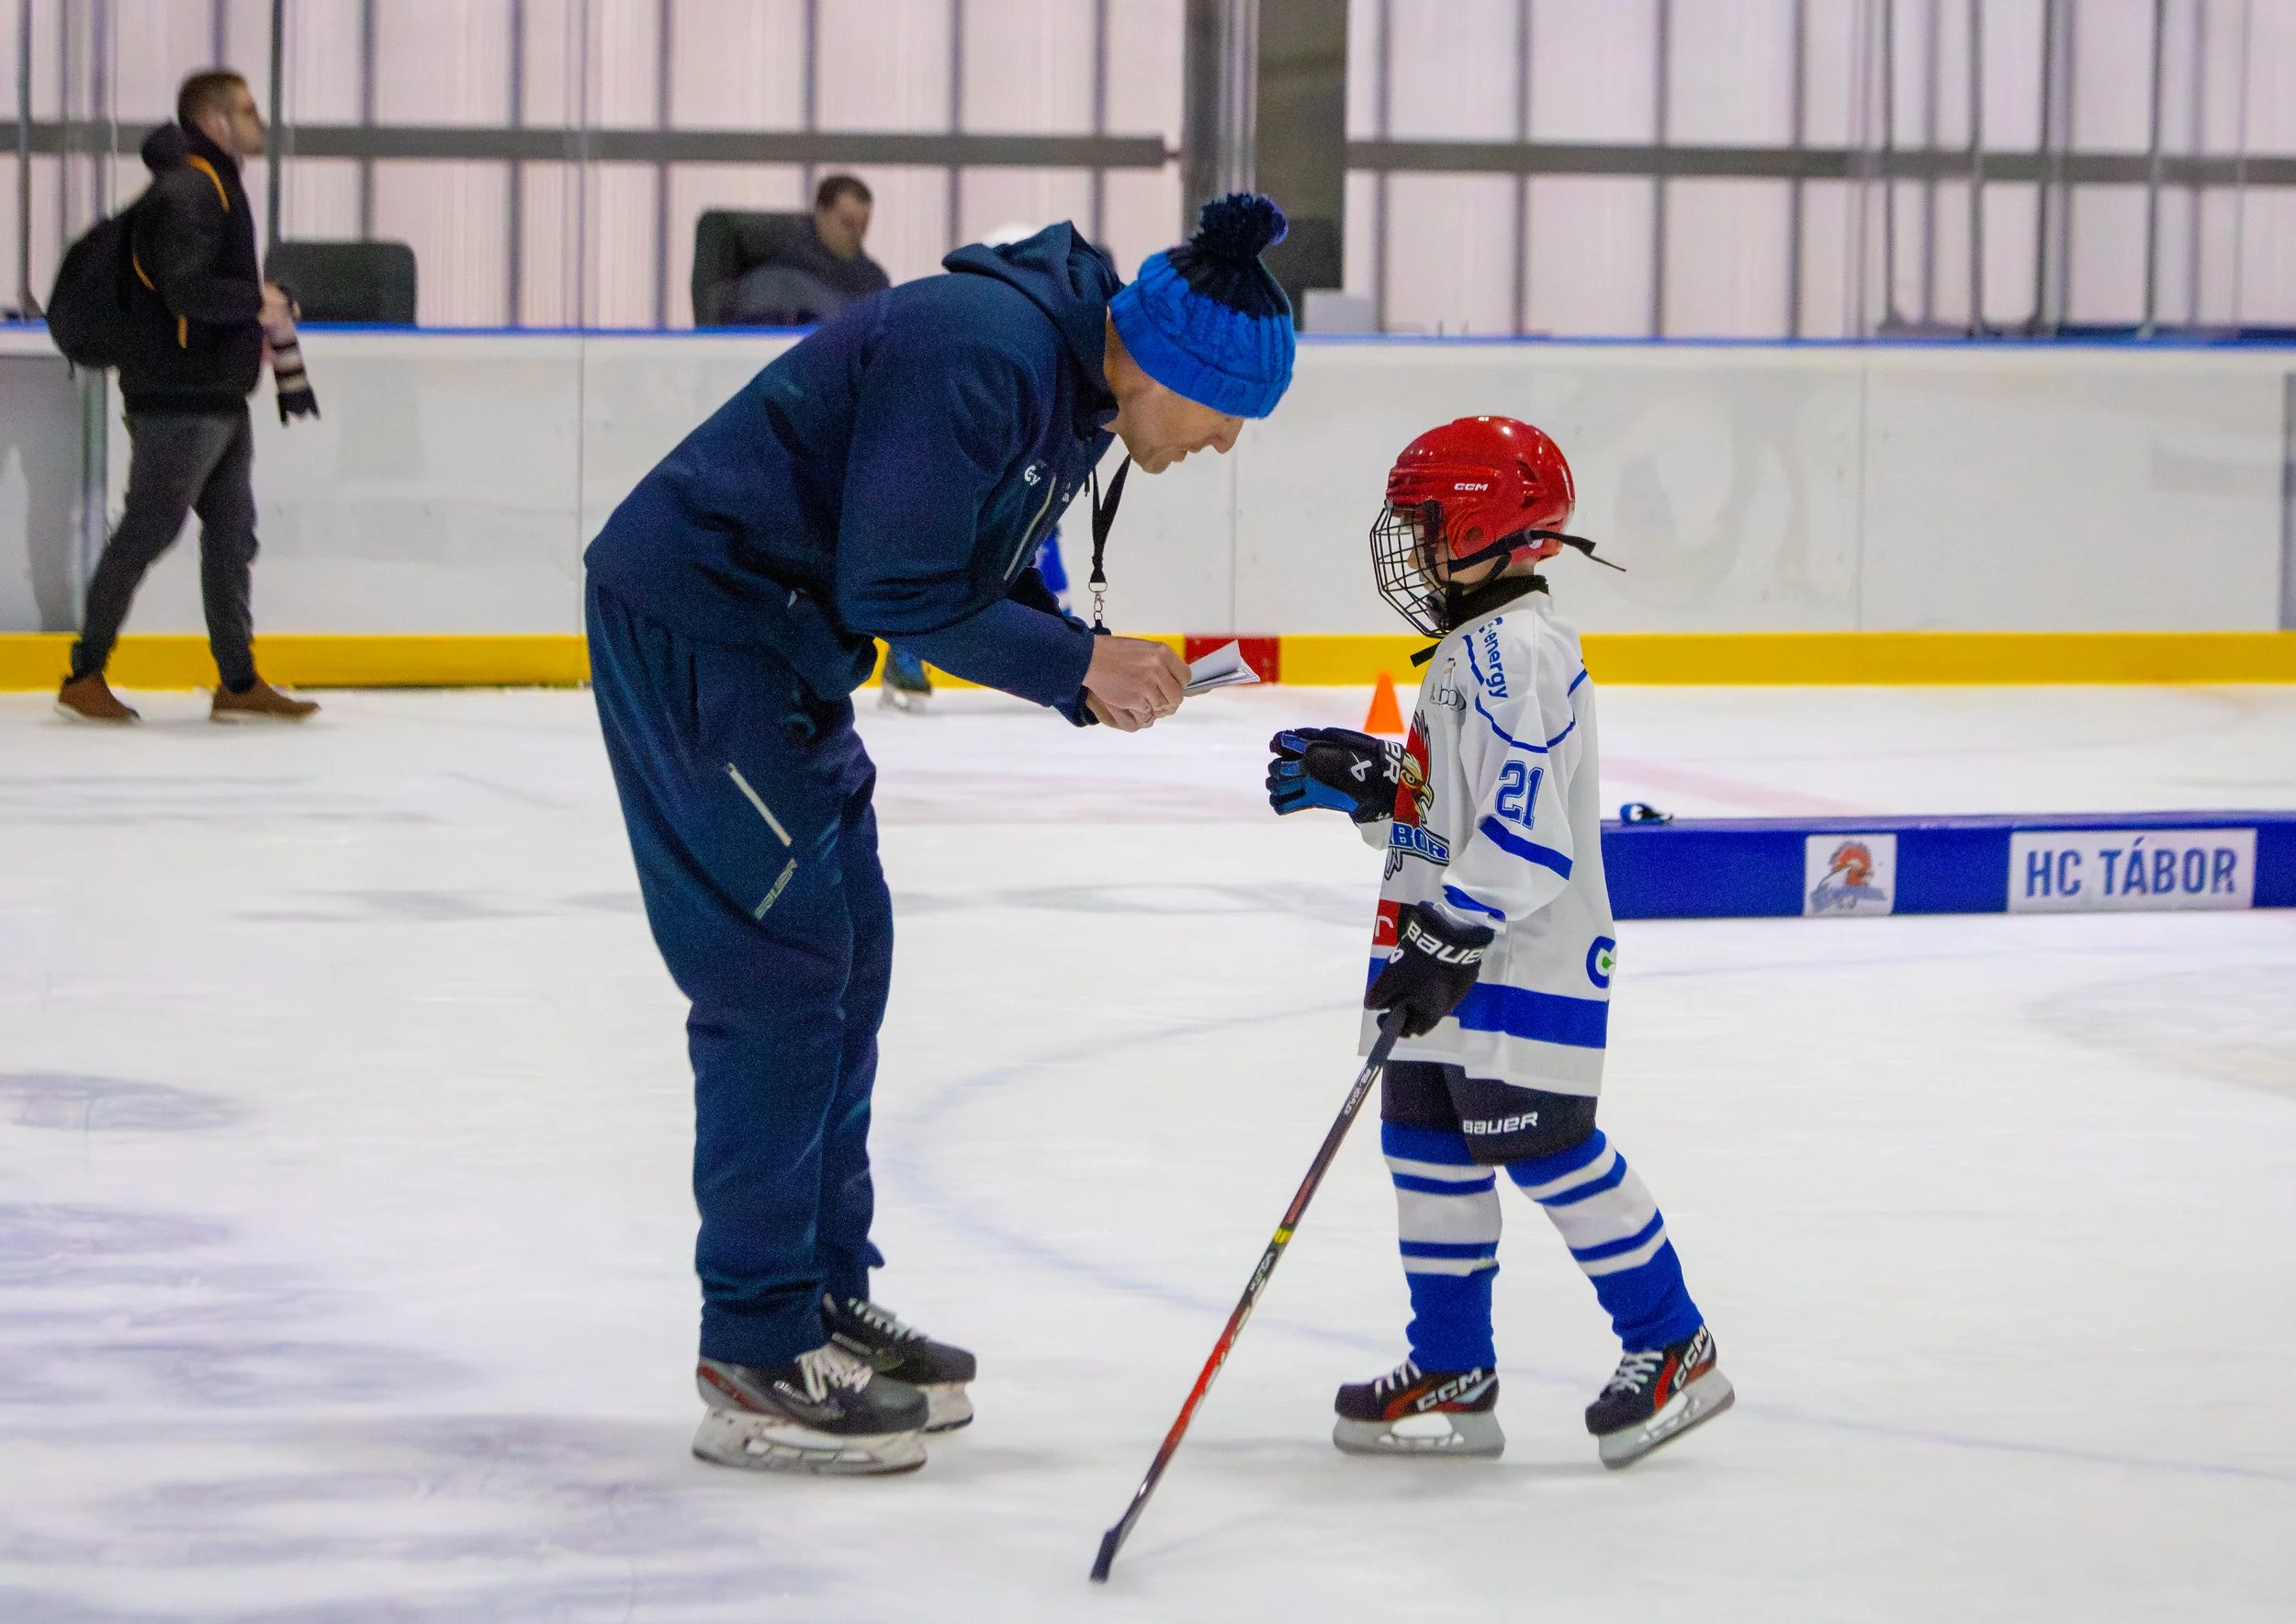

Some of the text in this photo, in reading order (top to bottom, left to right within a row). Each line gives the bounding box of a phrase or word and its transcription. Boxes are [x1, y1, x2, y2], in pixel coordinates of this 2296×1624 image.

[1454, 482, 1489, 491] CCM
[1495, 760, 1544, 830] 21
[1390, 821, 1449, 861] BOR
[2026, 836, 2238, 897] HC TÁBOR
[1407, 920, 1484, 964] BAUE
[1463, 1111, 1538, 1135] BAUER
[1416, 1367, 1483, 1412] CCM
